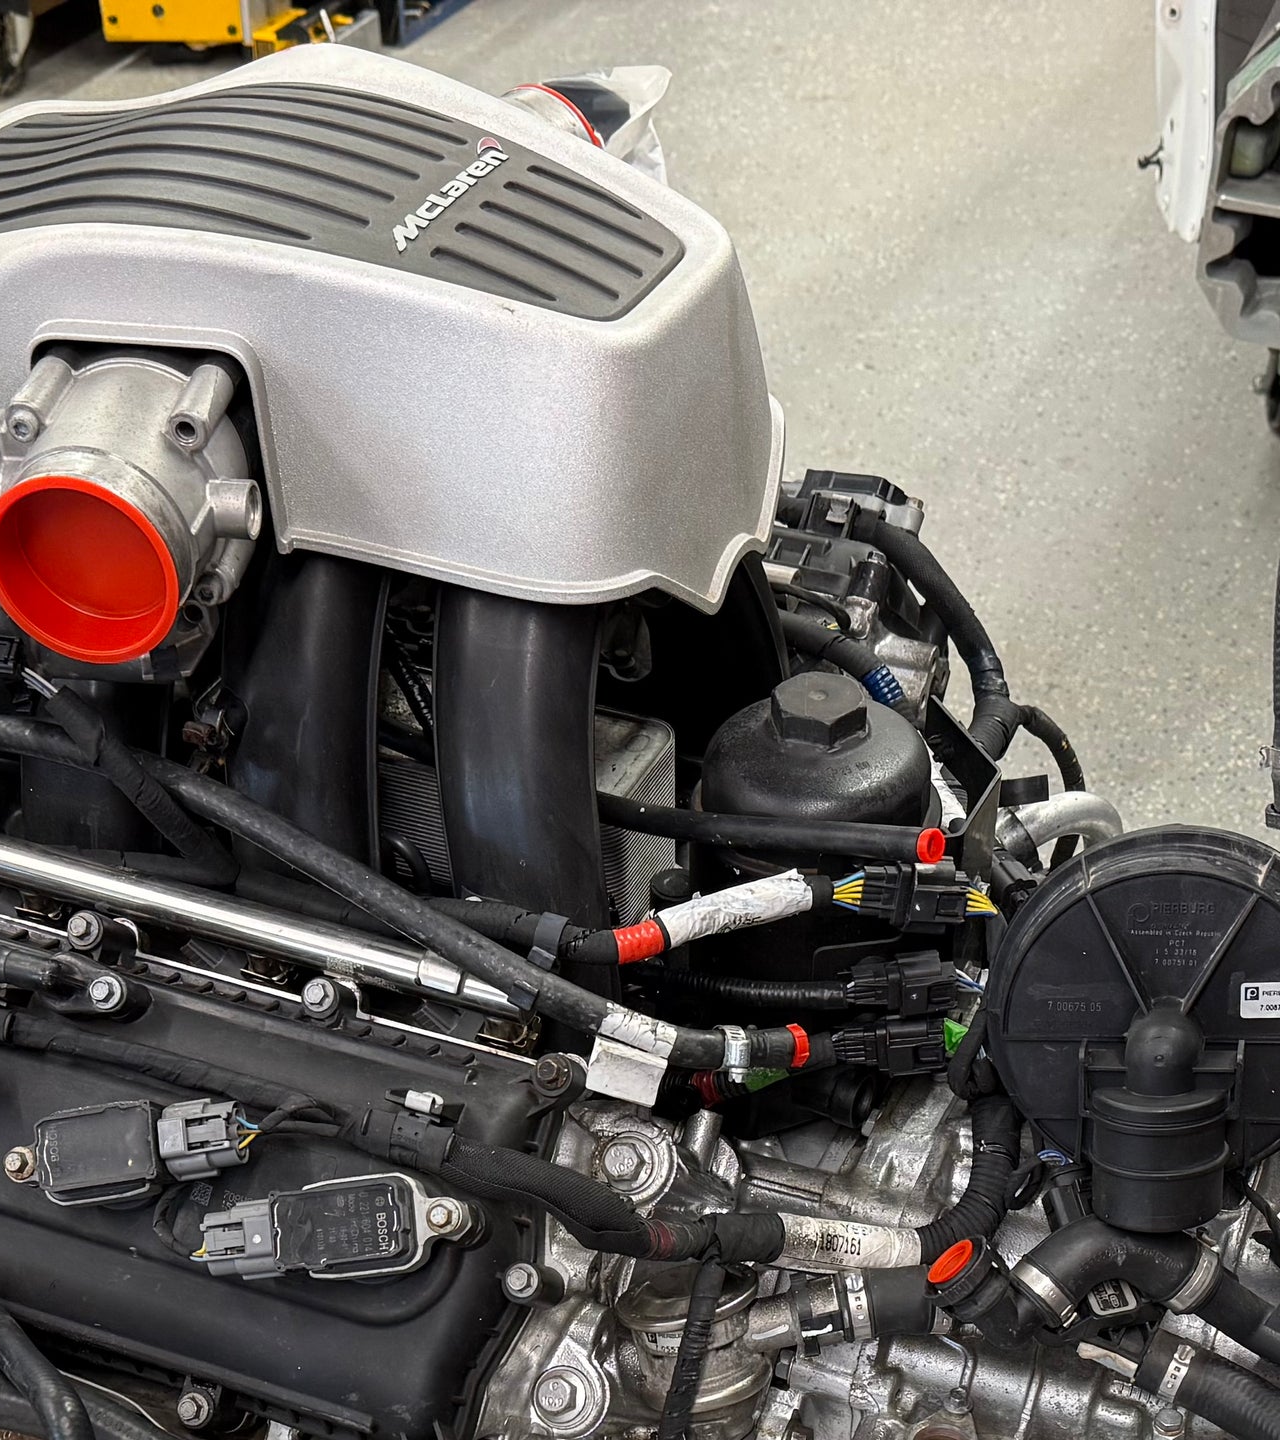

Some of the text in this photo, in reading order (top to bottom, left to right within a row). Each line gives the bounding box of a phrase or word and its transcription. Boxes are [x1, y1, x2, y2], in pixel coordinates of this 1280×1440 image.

[392, 149, 510, 254] McLaren
[1151, 901, 1216, 914] PIERBURG
[48, 1125, 60, 1162] BOSCH
[376, 1212, 390, 1251] BOSCH
